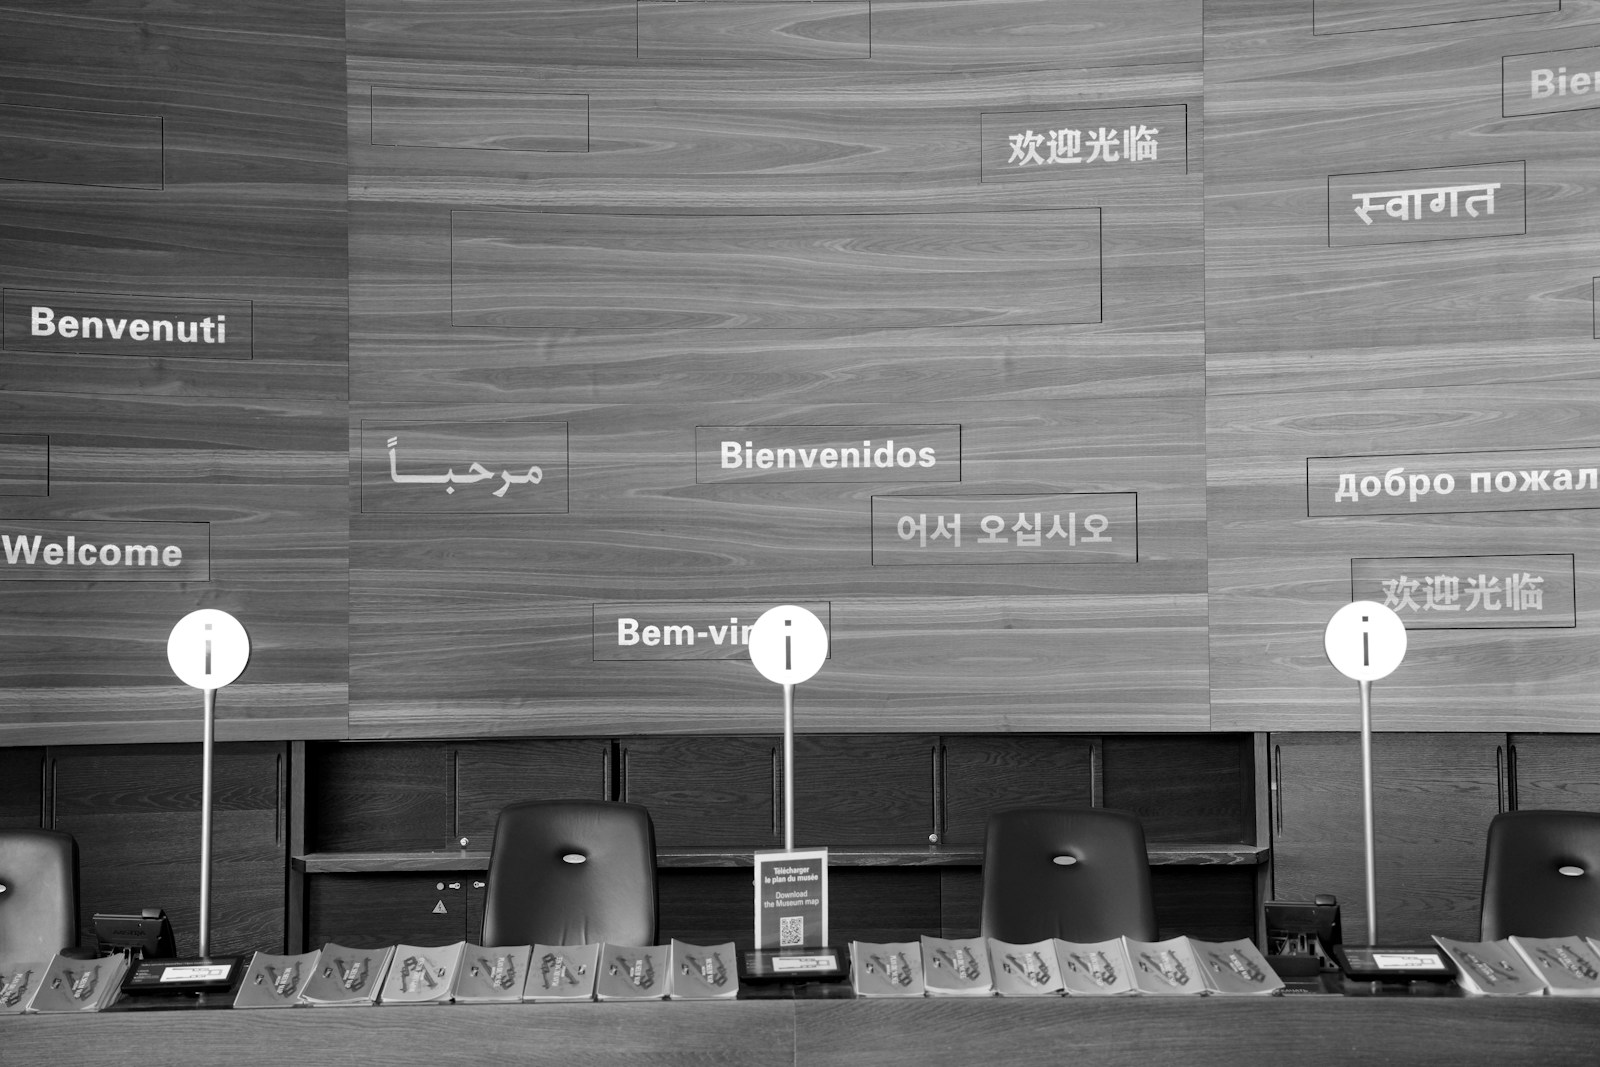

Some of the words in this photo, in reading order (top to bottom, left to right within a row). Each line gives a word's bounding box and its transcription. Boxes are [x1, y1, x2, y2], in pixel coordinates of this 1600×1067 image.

[1008, 125, 1159, 167] 欢迎光临
[1352, 183, 1501, 226] स्वागत
[30, 306, 226, 344] Benvenuti
[720, 440, 936, 470] Bienvenidos
[1470, 468, 1598, 493] пожал
[897, 513, 961, 548] 어서
[977, 511, 1113, 547] 오십시오
[1, 534, 183, 567] Welcome
[1382, 572, 1545, 612] 欢迎光临
[764, 876, 771, 884] le
[772, 875, 786, 885] plan
[787, 874, 796, 882] du
[797, 873, 819, 881] musée
[775, 890, 808, 899] Download
[776, 899, 804, 907] Museum
[805, 899, 820, 907] map
